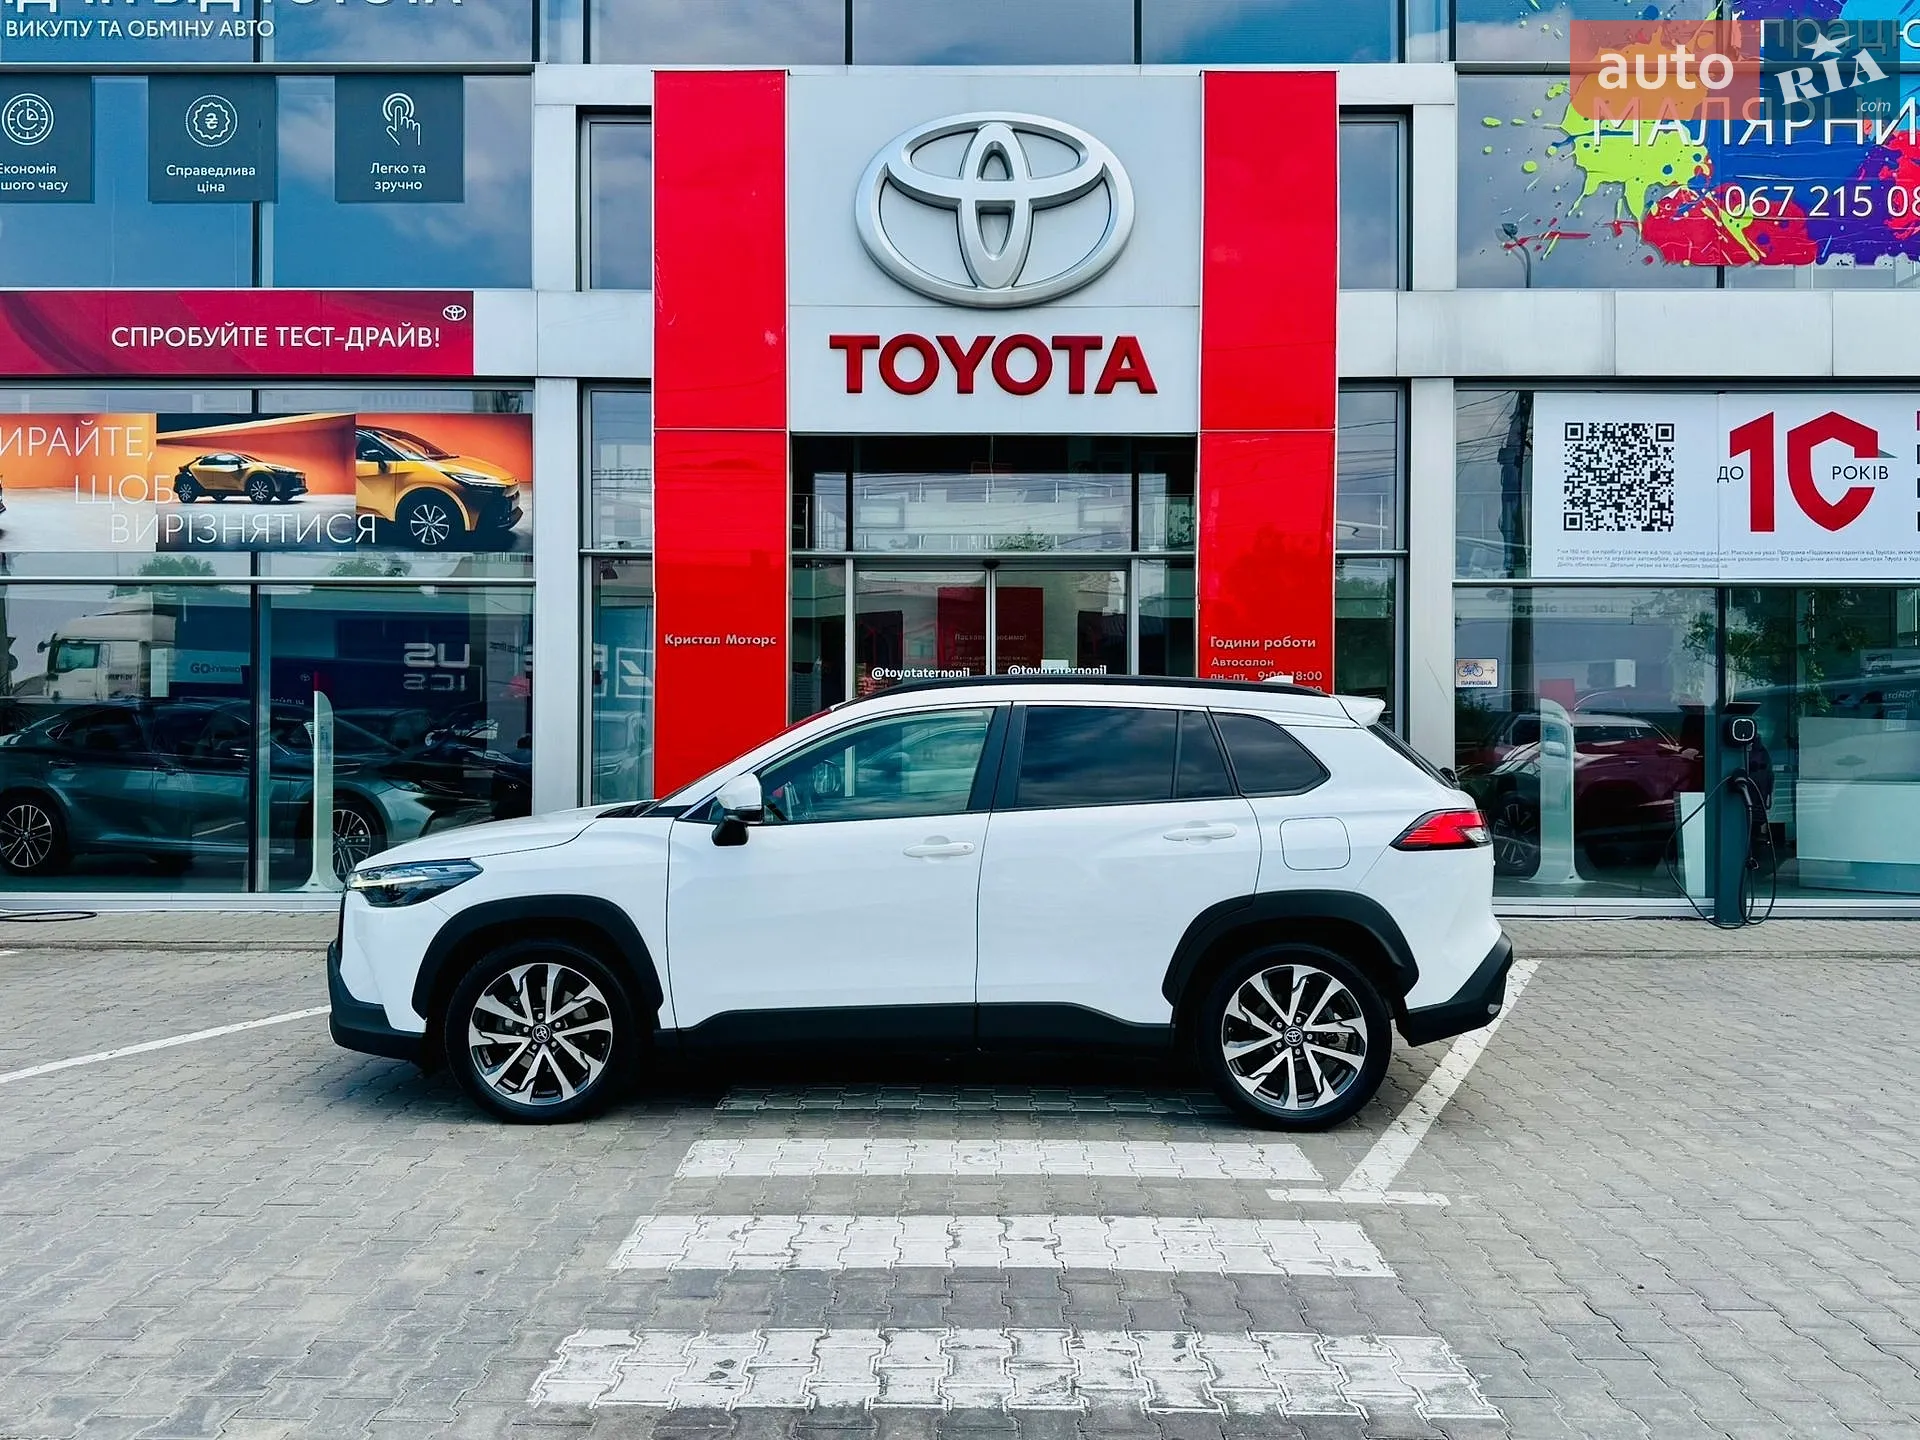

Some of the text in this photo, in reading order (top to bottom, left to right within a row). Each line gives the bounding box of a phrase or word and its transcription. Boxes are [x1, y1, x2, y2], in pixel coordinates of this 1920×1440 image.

[5, 20, 275, 37] ВИКУПУ ТА ОБМІНУ АВТО
[166, 164, 256, 178] Справедлива
[370, 163, 426, 176] Легко та
[39, 181, 69, 193] часу
[197, 180, 226, 195] ціна
[374, 179, 423, 192] зручно
[1725, 185, 1795, 217] 067
[1808, 185, 1873, 217] 215
[111, 322, 440, 351] СПРОБУЙТЕ ТЕСТ-ДРАЙВ!
[829, 333, 1159, 396] TOYOTA
[0, 420, 153, 465] ИРАЙТЕ,
[1716, 466, 1744, 483] ДО
[1831, 465, 1889, 480] РОКІВ
[75, 474, 174, 511] ЩОБ
[111, 513, 377, 544] ВИРІЗНЯТИСЯ
[664, 634, 777, 647] Кристал Моторс
[1210, 635, 1316, 651] Години роботи
[1210, 657, 1274, 667] Автосалон
[871, 667, 971, 680] @toyotaternopil
